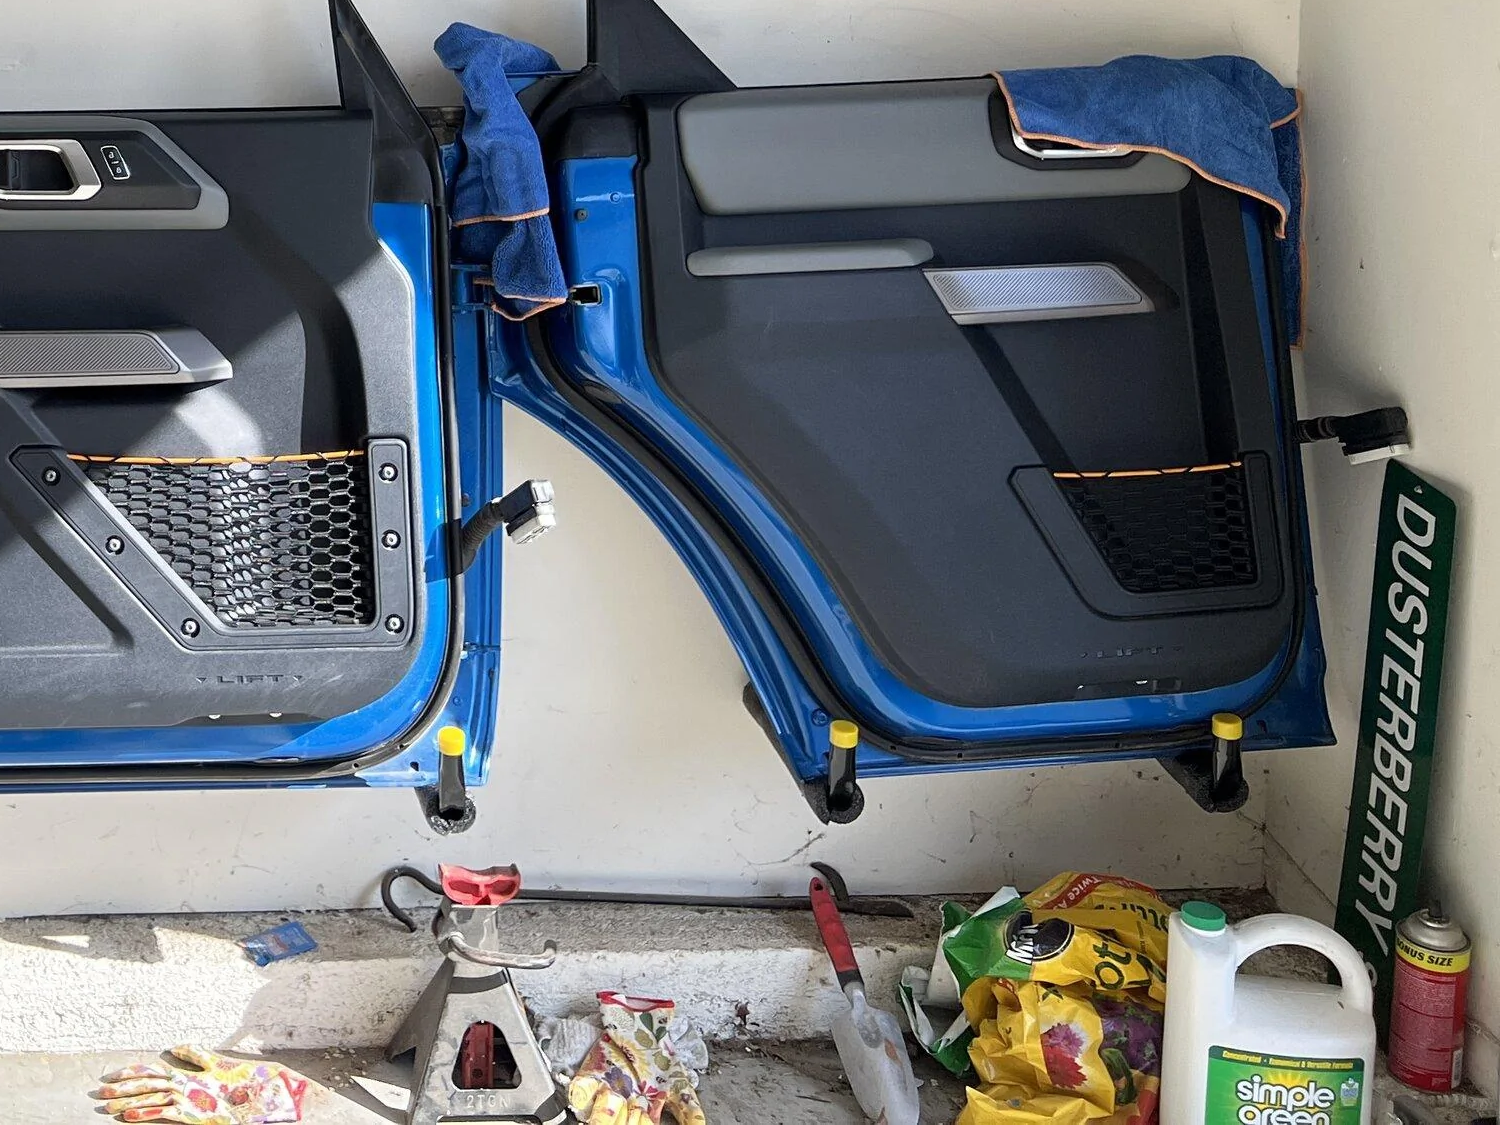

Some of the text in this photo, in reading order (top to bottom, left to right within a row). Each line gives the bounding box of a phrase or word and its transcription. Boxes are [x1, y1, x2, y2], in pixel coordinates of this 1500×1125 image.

[217, 674, 284, 684] LIFT
[1355, 493, 1437, 957] DUSTERBERRY
[1067, 876, 1102, 902] Twice
[1427, 955, 1454, 967] SIZE
[1236, 1074, 1335, 1111] simple
